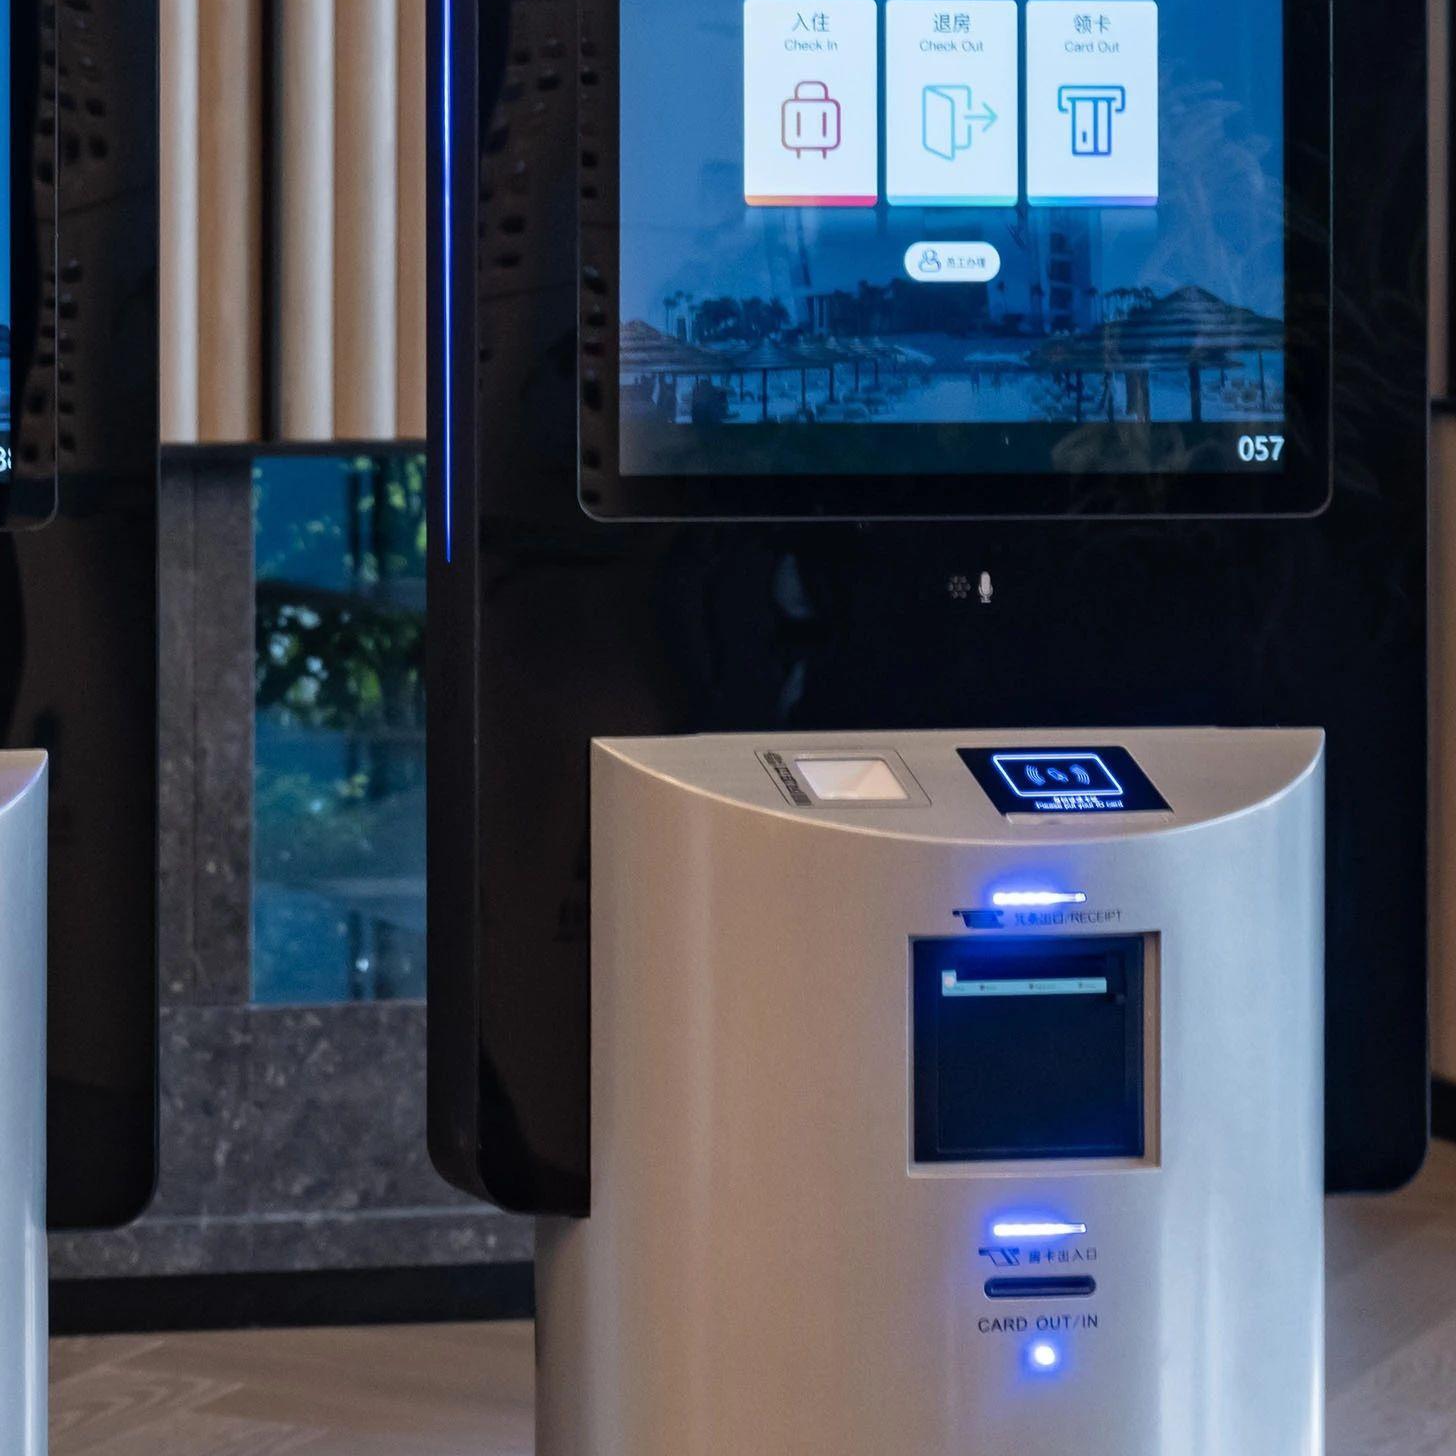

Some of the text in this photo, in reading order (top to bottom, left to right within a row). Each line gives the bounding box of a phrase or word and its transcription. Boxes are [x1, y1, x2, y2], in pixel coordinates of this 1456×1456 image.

[792, 12, 831, 33] 入住
[933, 13, 972, 34] 退房
[1073, 14, 1112, 34] 领卡
[783, 38, 839, 53] Check In
[919, 39, 984, 53] Check Out
[1064, 40, 1120, 55] Card Out
[1237, 434, 1285, 462] 057
[978, 1313, 1099, 1334] CARD OUT/IN
